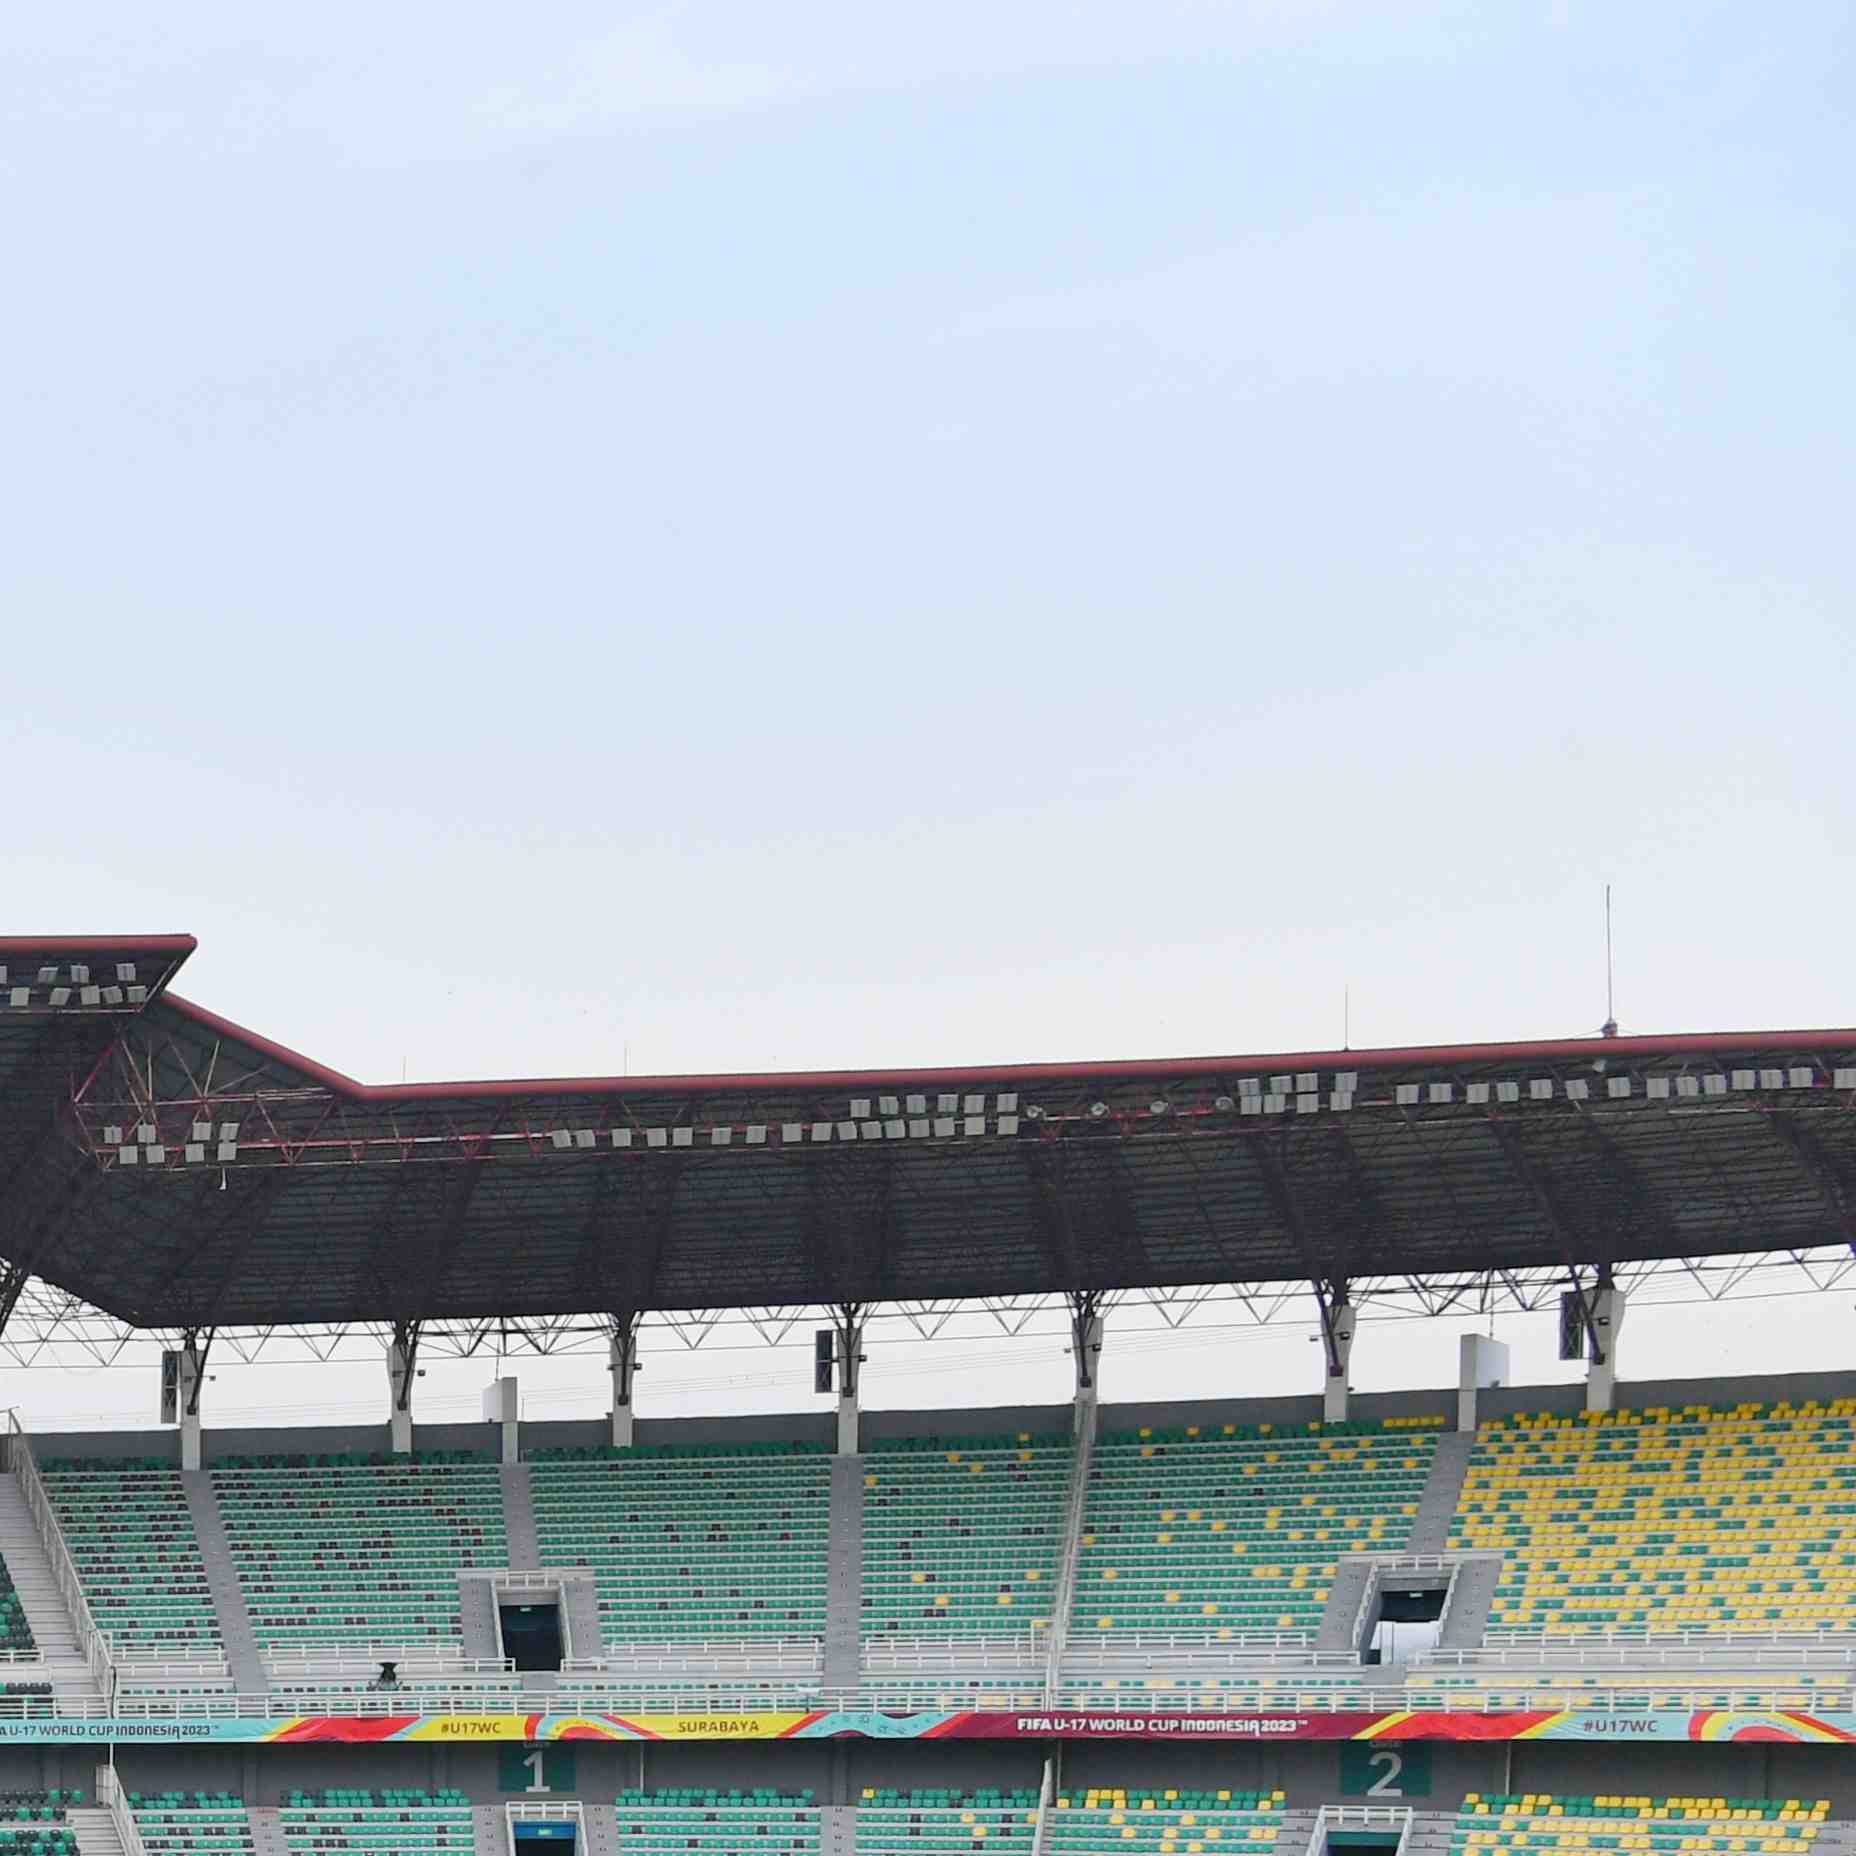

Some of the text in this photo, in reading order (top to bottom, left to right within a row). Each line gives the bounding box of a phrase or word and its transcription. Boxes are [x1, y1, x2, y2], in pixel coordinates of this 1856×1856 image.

[9, 1726, 36, 1736] U-17
[39, 1725, 85, 1736] WORLD
[88, 1725, 114, 1736] CUP
[115, 1725, 180, 1739] INDONESIA
[441, 1722, 501, 1734] #U17WC
[678, 1721, 759, 1733] SURABAYA
[1017, 1718, 1052, 1731] FIFA
[1054, 1718, 1086, 1730] U-17
[1088, 1718, 1143, 1731] WORLD
[1148, 1718, 1180, 1731] CUP
[1181, 1718, 1260, 1736] INDONESIA
[1583, 1719, 1658, 1733] #U17WC
[523, 1750, 551, 1793] 1
[1367, 1751, 1402, 1797] 2
